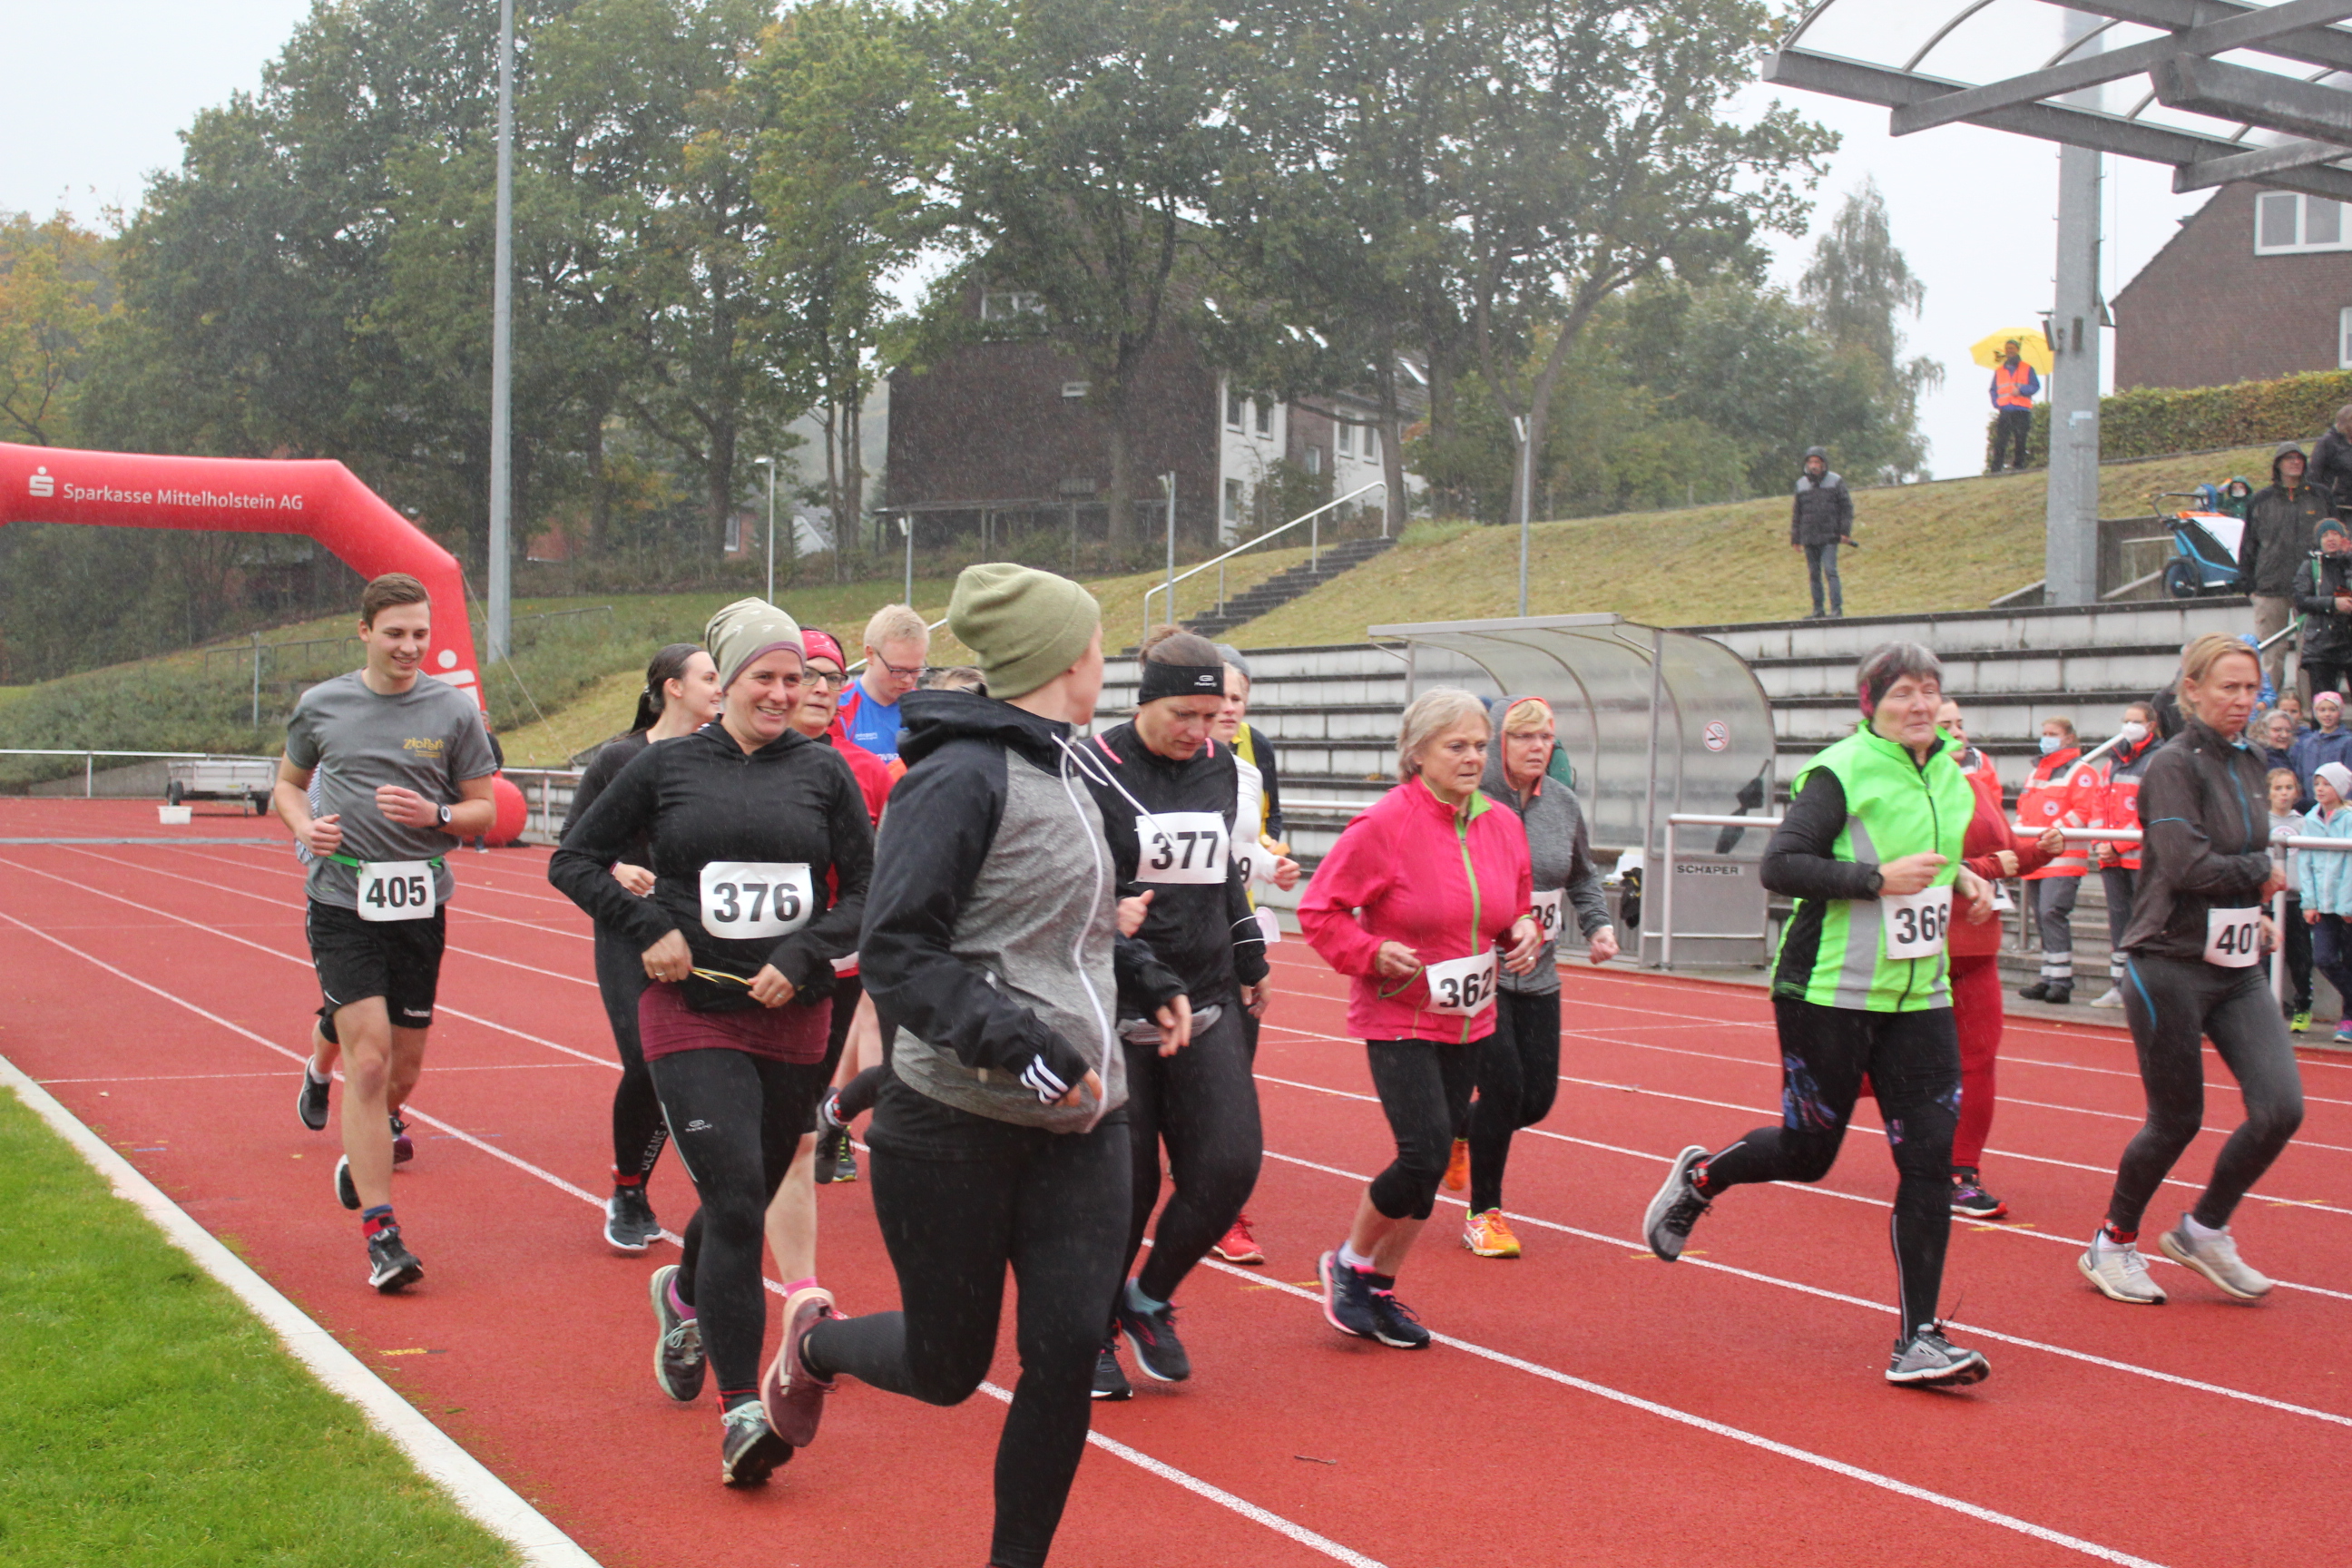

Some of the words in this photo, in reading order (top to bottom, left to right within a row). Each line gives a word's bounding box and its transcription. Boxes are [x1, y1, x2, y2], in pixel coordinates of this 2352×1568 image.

[63, 483, 152, 505] Sparkasse
[157, 489, 275, 510] Mittelholstein
[279, 495, 303, 510] AG
[1151, 830, 1219, 870] 377
[366, 876, 426, 908] 405
[713, 882, 800, 923] 376
[1896, 903, 1948, 945] 366
[1439, 966, 1493, 1008] 362
